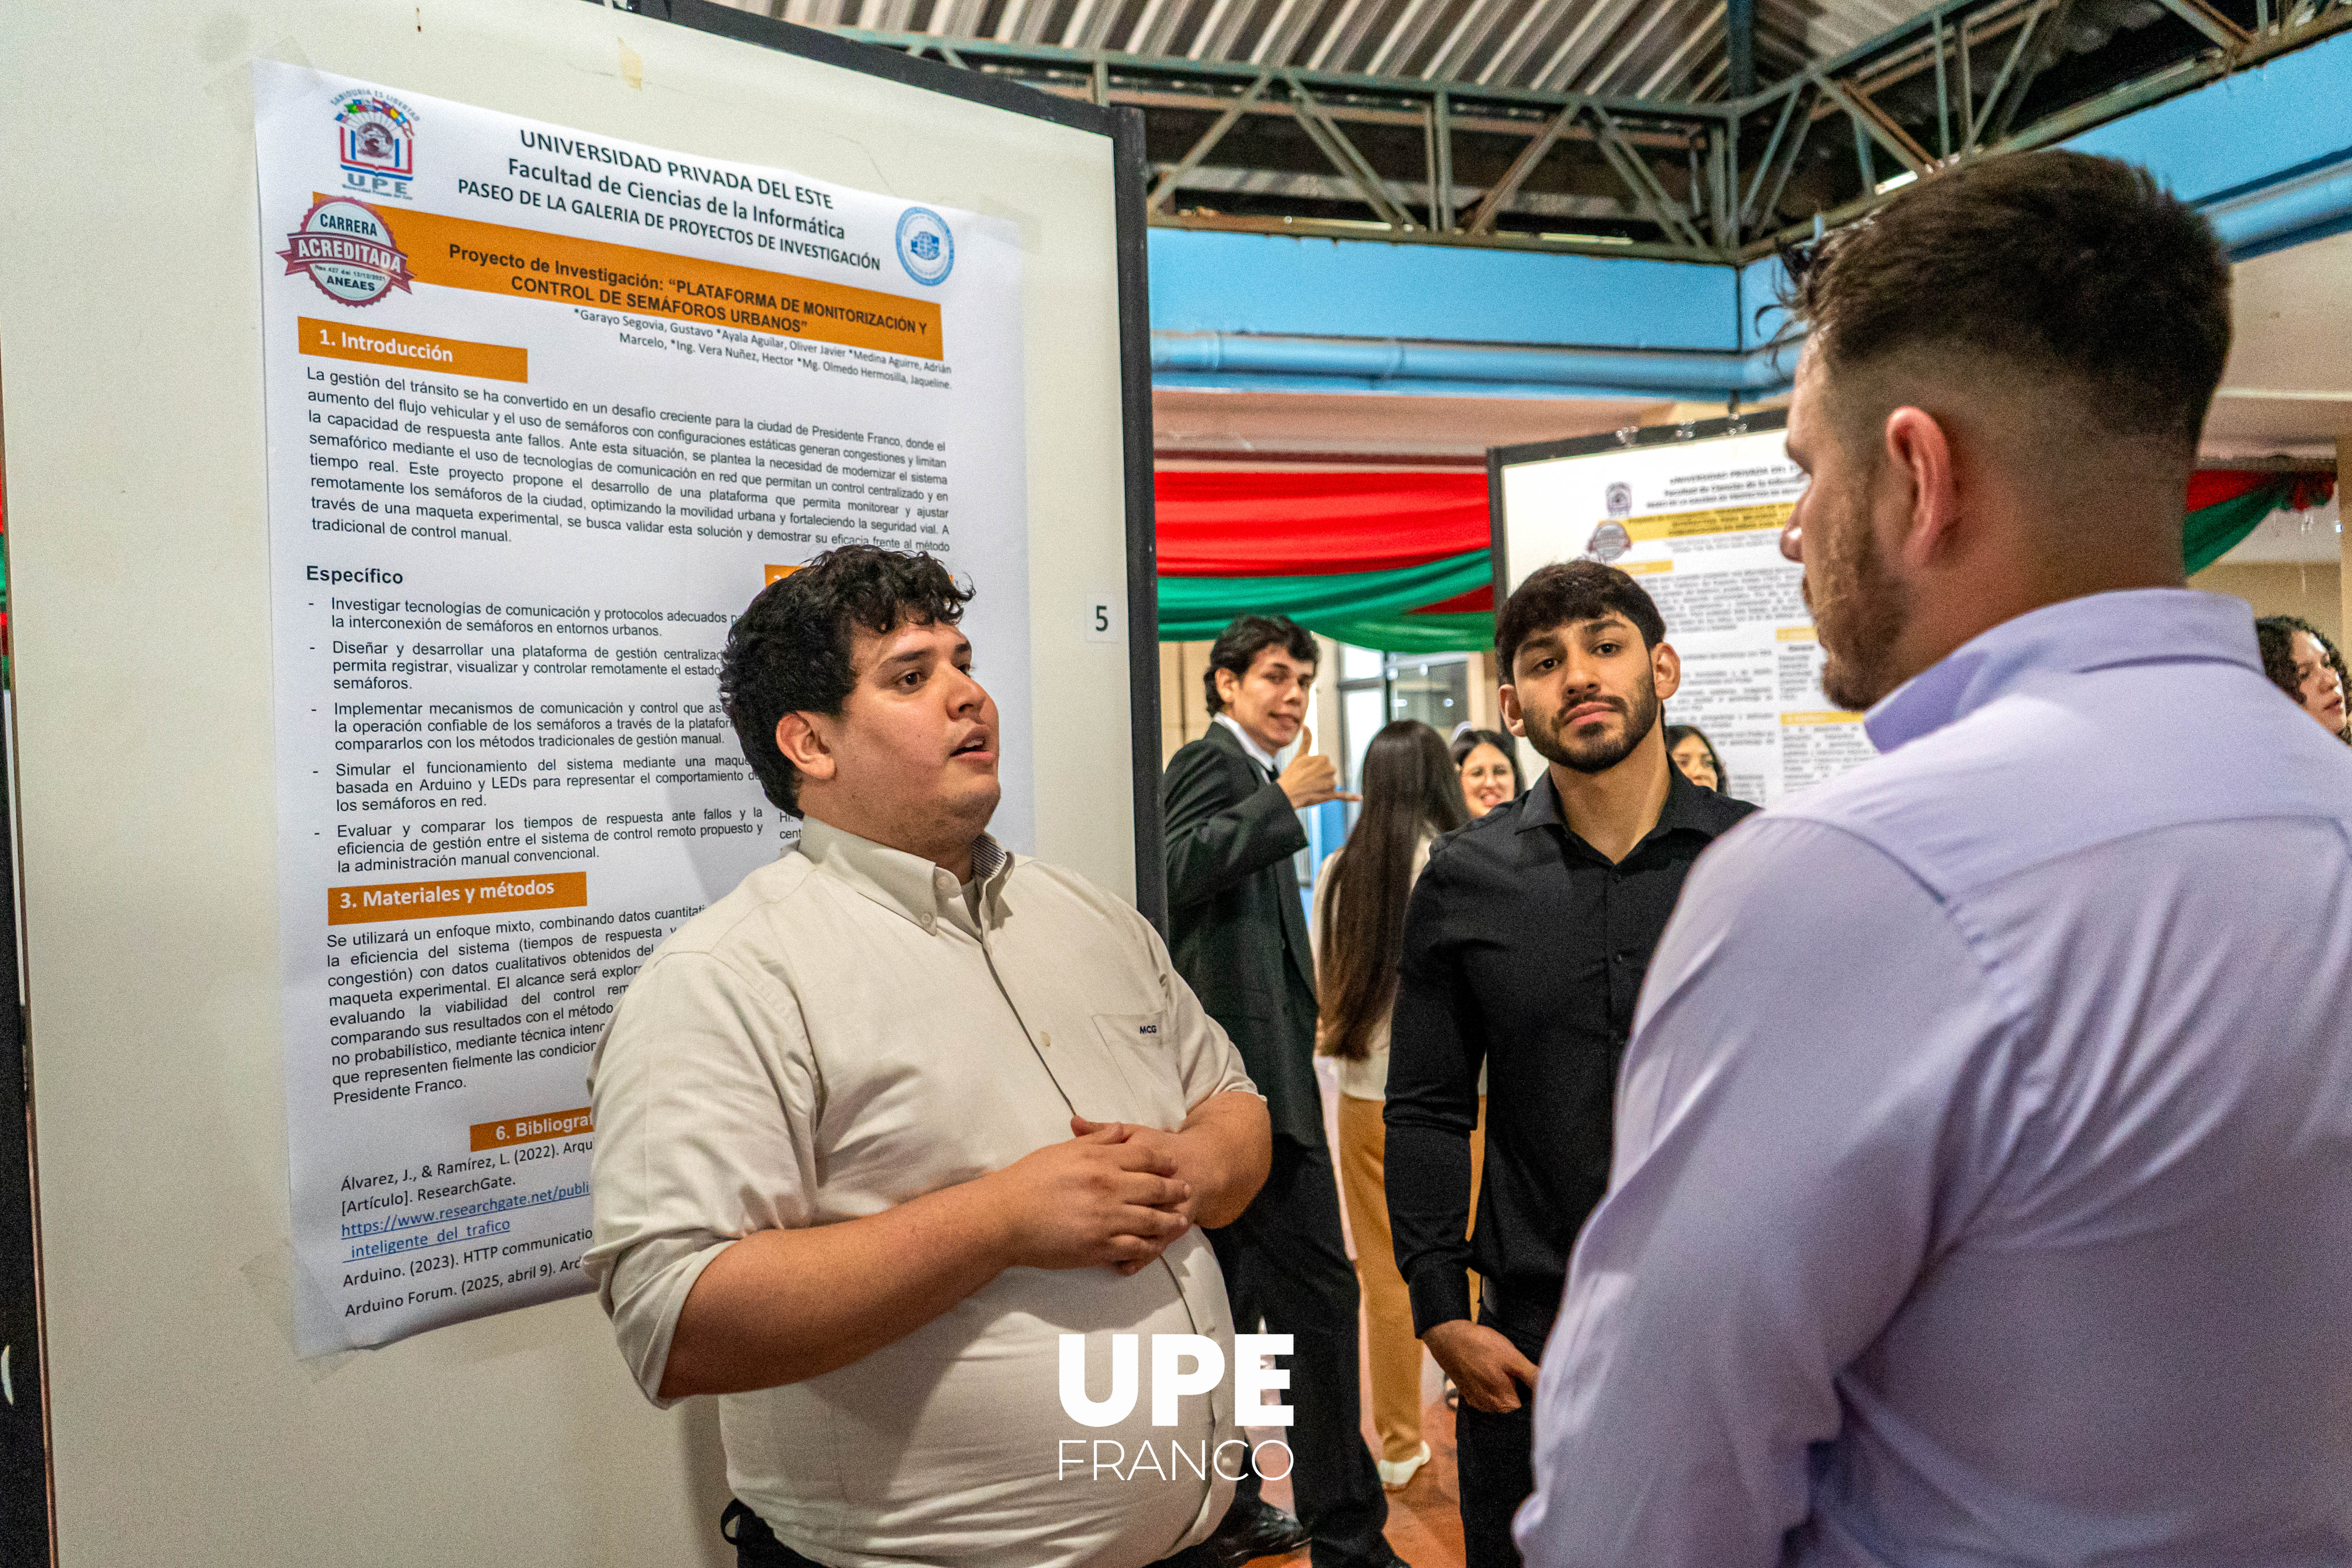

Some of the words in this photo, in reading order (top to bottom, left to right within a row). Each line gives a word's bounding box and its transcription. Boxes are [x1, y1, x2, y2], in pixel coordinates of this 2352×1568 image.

[347, 173, 407, 194] UPE
[520, 129, 662, 173] UNIVERSIDAD
[667, 161, 753, 192] PRIVADA
[757, 178, 791, 200] DEL
[795, 186, 833, 209] ESTE
[508, 157, 592, 190] Facultad
[598, 175, 621, 195] de
[627, 181, 701, 211] Ciencias
[707, 196, 728, 216] de
[733, 200, 747, 219] la
[753, 205, 845, 239] Informática
[320, 213, 377, 236] CARRERA
[458, 178, 514, 202] PASEO
[520, 189, 541, 207] DE
[547, 194, 567, 212] LA
[571, 199, 640, 225] GALERIA
[645, 212, 664, 229] DE
[669, 217, 754, 246] PROYECTOS
[758, 234, 775, 250] DE
[780, 238, 880, 271] INVESTIGACIÓN
[298, 239, 401, 274] ACREDITADA
[326, 275, 376, 291] ANEAES
[449, 243, 525, 269] Proyecto
[530, 257, 550, 273] de
[555, 260, 663, 291] Investigación:
[669, 279, 777, 309] “PLATAFORMA
[781, 297, 800, 313] DE
[803, 301, 916, 333] MONITORIZACIÓN
[918, 322, 927, 335] Y
[511, 276, 595, 301] CONTROL
[600, 289, 622, 306] DE
[626, 293, 726, 321] SEMÁFOROS
[730, 309, 808, 333] URBANOS”
[319, 329, 336, 346] 1.
[341, 331, 453, 363] Introducción
[619, 332, 667, 351] Marcelo,
[698, 343, 723, 356] Vera
[725, 347, 759, 363] Nuñez,
[762, 353, 794, 366] Hector
[822, 361, 859, 376] Olmedo
[623, 316, 667, 333] Segovia,
[670, 323, 714, 338] Gustavo
[751, 335, 787, 351] Aguilar,
[789, 341, 817, 353] Oliver
[820, 346, 846, 357] Javier
[889, 357, 922, 371] Aguirre,
[923, 363, 952, 374] Adrián
[309, 453, 359, 471] tiempo
[368, 460, 398, 473] real.
[409, 461, 439, 477] Este
[448, 468, 504, 483] proyecto
[513, 474, 564, 488] propone
[572, 477, 582, 489] el
[591, 479, 650, 495] desarrollo
[657, 484, 672, 496] de
[680, 488, 702, 499] una
[709, 489, 768, 504] plataforma
[775, 496, 796, 507] que
[803, 498, 841, 510] permita
[847, 502, 899, 514] monitorear
[905, 508, 911, 518] y
[917, 508, 949, 519] ajustar
[311, 518, 385, 534] tradicional
[389, 523, 407, 536] de
[411, 526, 456, 539] control
[460, 530, 511, 542] manual.
[306, 565, 403, 585] Específico
[331, 615, 344, 628] la
[349, 615, 442, 630] interconexión
[446, 618, 463, 631] de
[466, 620, 534, 633] semáforos
[537, 624, 553, 633] en
[556, 623, 609, 635] entornos
[612, 624, 662, 637] urbanos.
[1096, 605, 1109, 632] 5
[335, 737, 423, 753] compararlos
[427, 739, 452, 749] con
[456, 736, 475, 749] los
[479, 735, 535, 748] métodos
[538, 734, 615, 747] tradicionales
[618, 734, 633, 746] de
[636, 733, 677, 748] gestión
[681, 733, 724, 744] manual.
[336, 799, 357, 812] los
[362, 796, 436, 811] semáforos
[440, 798, 457, 808] en
[461, 794, 486, 807] red.
[338, 860, 350, 873] la
[354, 855, 456, 872] administración
[461, 851, 510, 866] manual
[513, 846, 599, 863] convencional.
[340, 892, 357, 909] 3.
[363, 886, 460, 907] Materiales
[464, 887, 475, 903] y
[480, 880, 555, 899] métodos
[328, 967, 413, 988] congestión)
[420, 967, 445, 978] con
[451, 962, 489, 976] datos
[495, 955, 567, 971] cualitativos
[572, 948, 631, 963] obtenidos
[636, 943, 654, 957] del
[331, 1025, 421, 1046] comparando
[425, 1023, 449, 1035] sus
[453, 1014, 522, 1032] resultados
[525, 1012, 549, 1023] con
[553, 1007, 564, 1020] el
[568, 1002, 614, 1018] método
[1139, 1025, 1157, 1034] MCG
[334, 1085, 411, 1105] Presidente
[415, 1079, 466, 1094] Franco.
[495, 1125, 510, 1140] 6.
[341, 1174, 398, 1192] Álvarez,
[402, 1169, 417, 1182] J.,
[421, 1165, 433, 1178] &
[437, 1157, 495, 1176] Ramírez,
[500, 1153, 510, 1165] L.
[514, 1144, 559, 1165] (2022).
[563, 1141, 593, 1154] Arqu
[341, 1190, 413, 1217] [Artículo].
[418, 1176, 516, 1201] ResearchGate.
[341, 1181, 590, 1241] https://www.researchgate.net/publi
[343, 1267, 405, 1287] Arduino.
[410, 1254, 459, 1277] (2023).
[463, 1246, 498, 1264] HTTP
[502, 1228, 593, 1256] communicatio
[344, 1297, 404, 1317] Arduino
[408, 1287, 457, 1304] Forum.
[461, 1274, 503, 1296] (2025,
[508, 1266, 536, 1283] abril
[540, 1262, 555, 1277] 9).
